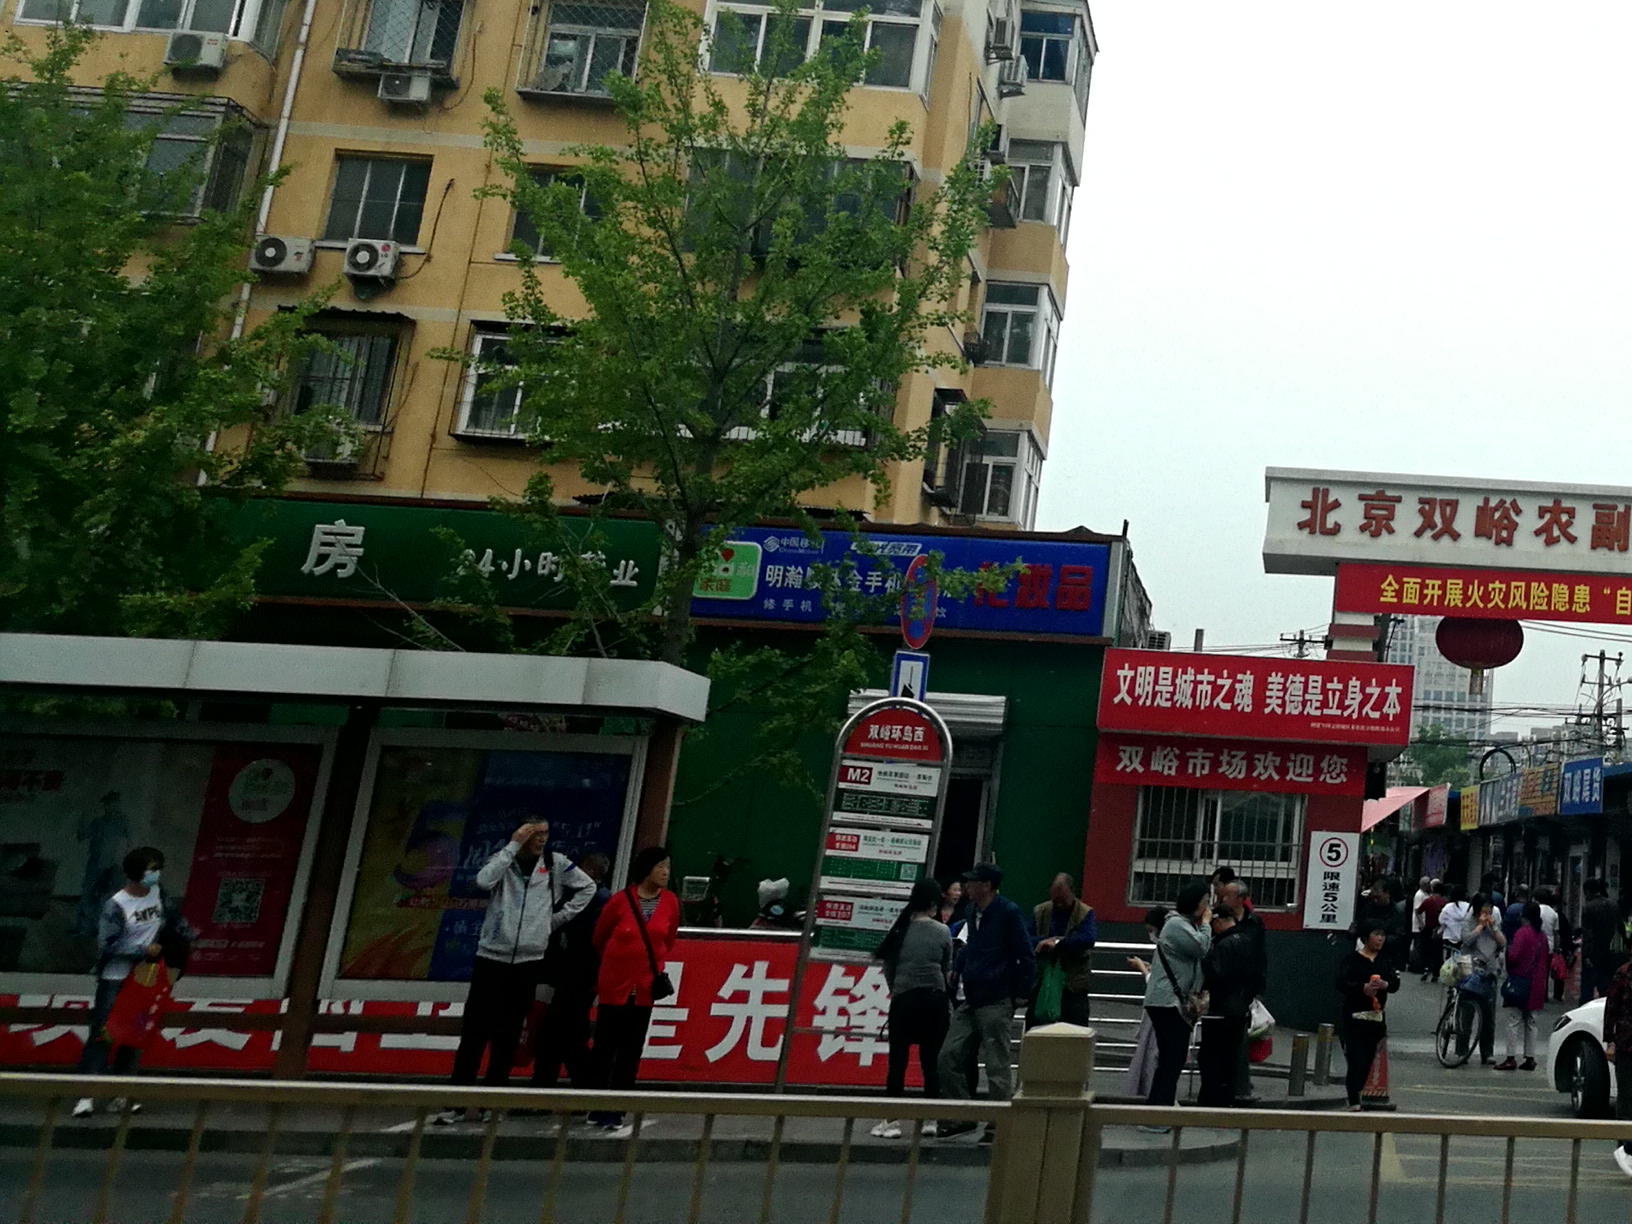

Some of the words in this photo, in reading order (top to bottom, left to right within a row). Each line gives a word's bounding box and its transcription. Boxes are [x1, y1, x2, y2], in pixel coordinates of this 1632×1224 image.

[300, 518, 365, 579] 房
[780, 537, 820, 550] 中国移
[1113, 663, 1254, 714] 文明是城市之魂
[1263, 671, 1403, 721] 美德是立身之本
[847, 767, 870, 783] M2
[1115, 744, 1350, 784] 双峪市场欢迎您
[1326, 842, 1341, 862] 5
[1319, 871, 1341, 924] 限速5公里
